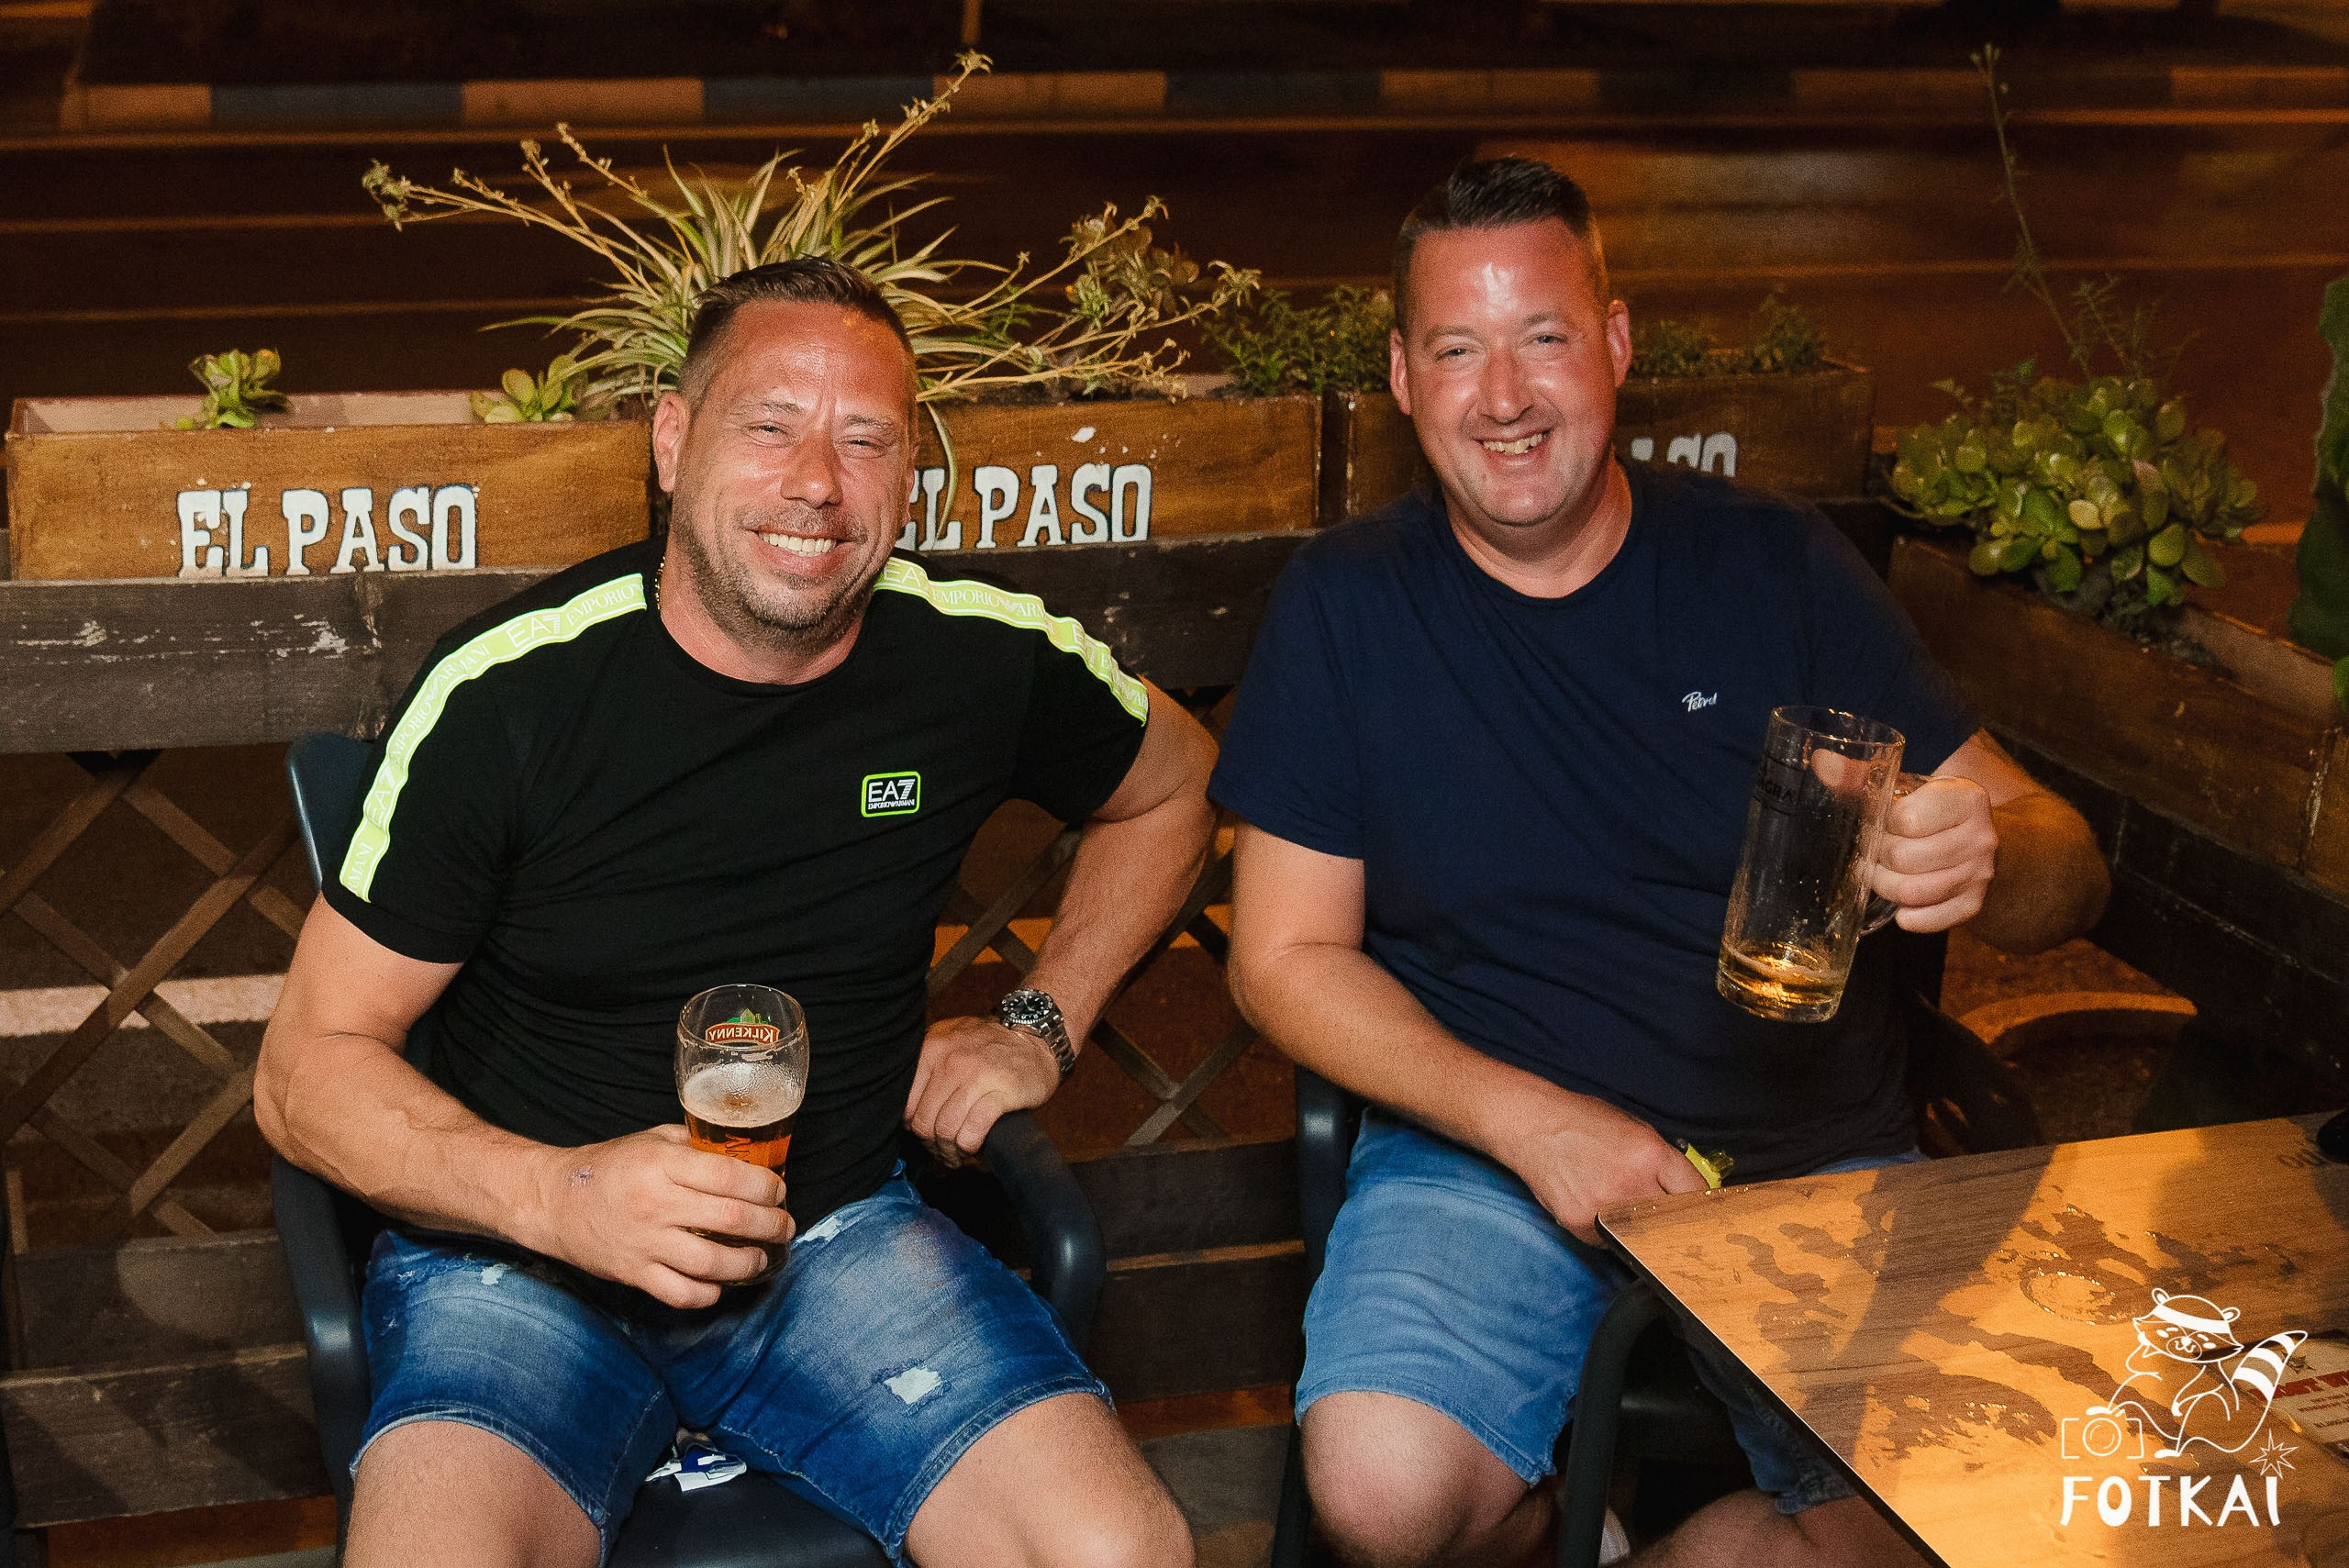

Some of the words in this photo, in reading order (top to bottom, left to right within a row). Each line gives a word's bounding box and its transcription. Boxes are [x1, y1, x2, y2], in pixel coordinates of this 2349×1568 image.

[177, 488, 270, 578] EL
[282, 485, 477, 576] PASO
[974, 463, 1152, 549] PASO
[506, 614, 562, 649] EA7
[566, 583, 636, 628] EMPORIO
[932, 589, 1001, 607] EMPORIO
[868, 778, 916, 803] EA7
